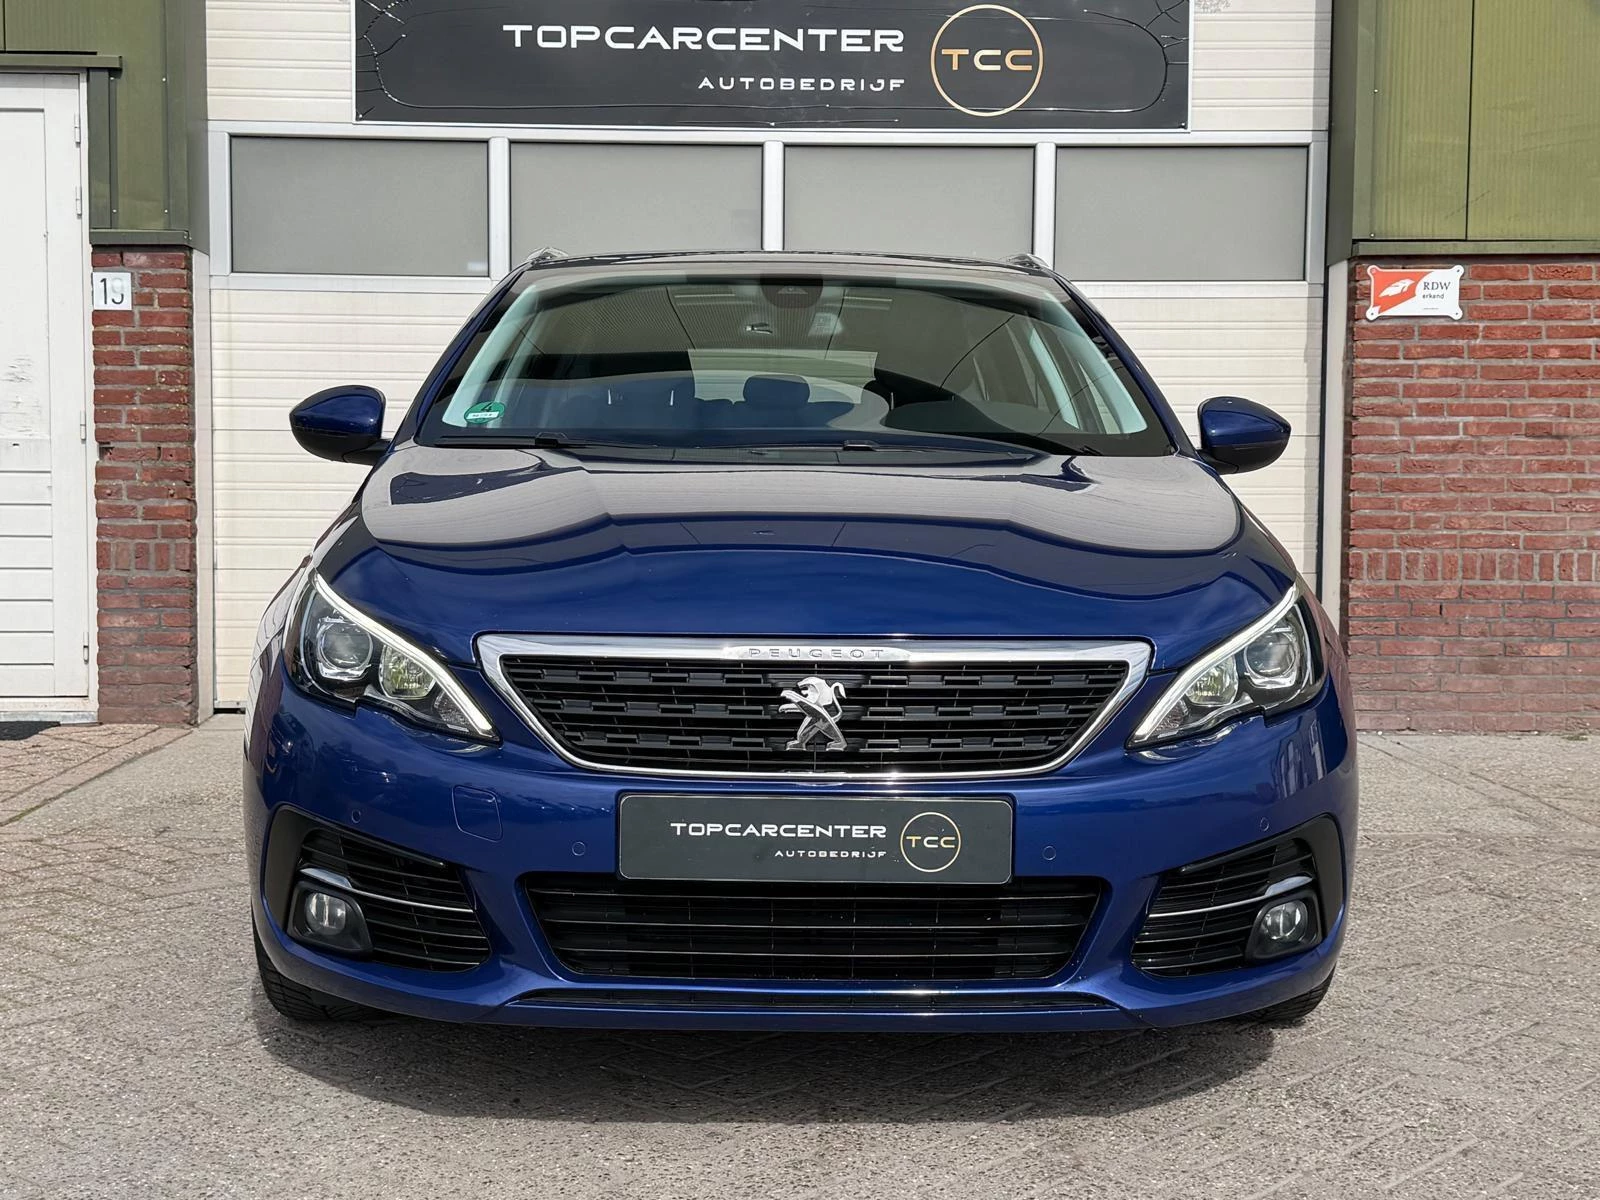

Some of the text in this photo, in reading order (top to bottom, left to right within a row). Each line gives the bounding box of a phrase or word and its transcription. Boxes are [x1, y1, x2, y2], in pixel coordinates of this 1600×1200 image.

[502, 24, 904, 53] TOPCARCENTER
[941, 48, 1033, 71] TCC
[698, 76, 905, 92] AUTOBEDRIJF
[100, 277, 124, 305] 19
[1423, 281, 1451, 291] RDW
[748, 648, 884, 659] PEUGEOT
[670, 822, 887, 839] TOPCARCENTER
[905, 836, 957, 849] TCC
[774, 849, 887, 859] AUTOBEDRIJF
